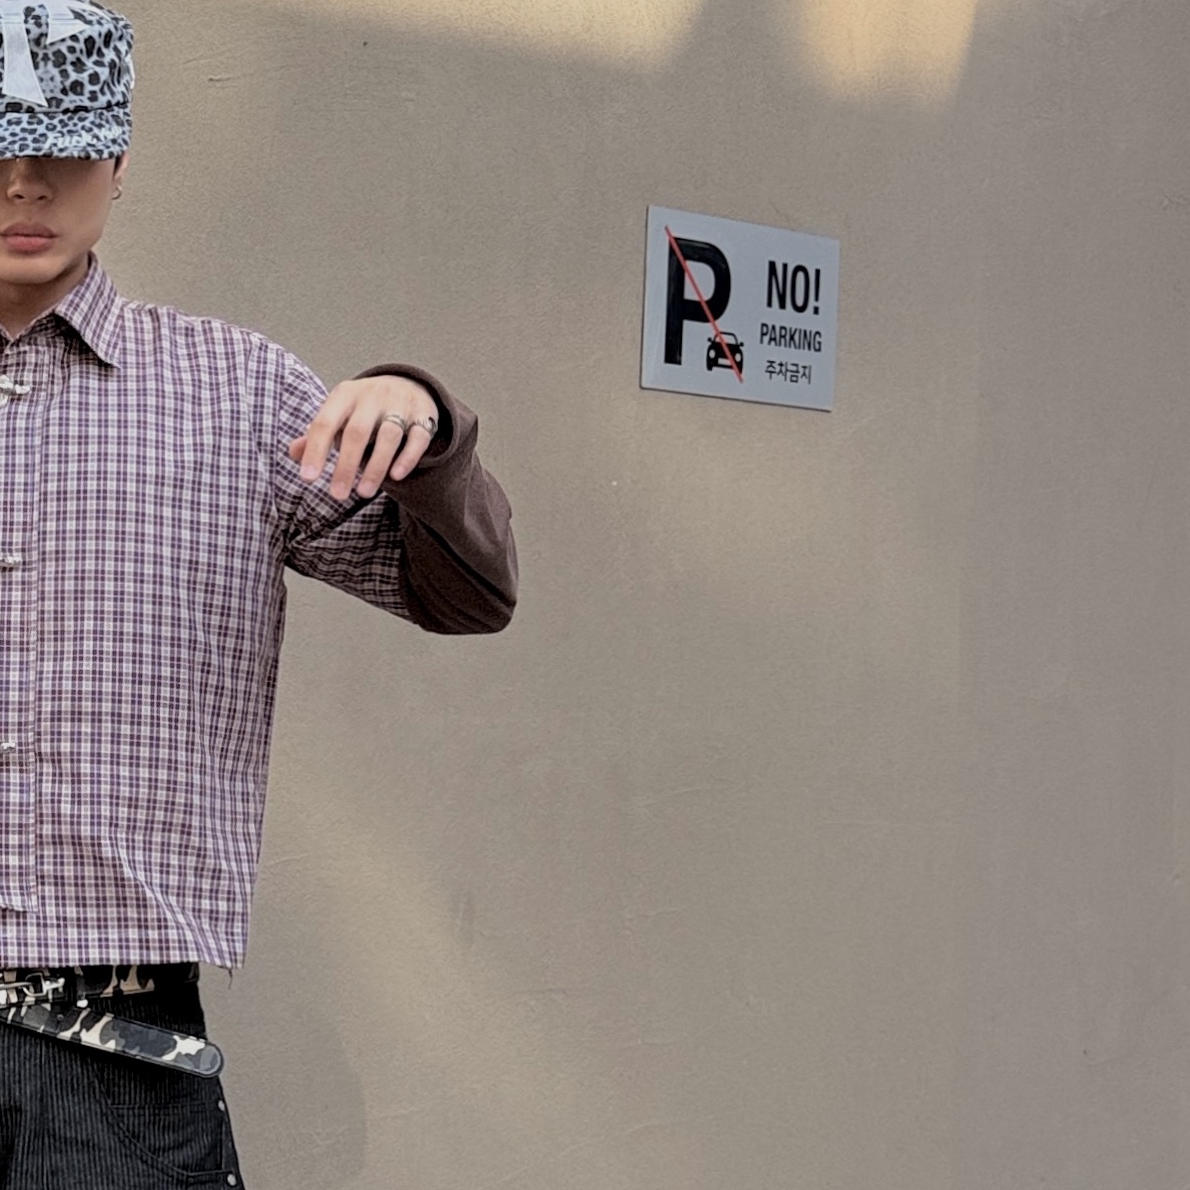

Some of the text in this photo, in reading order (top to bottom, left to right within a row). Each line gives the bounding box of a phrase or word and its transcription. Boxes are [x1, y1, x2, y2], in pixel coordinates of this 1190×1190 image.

[767, 260, 821, 315] NO!
[760, 322, 822, 352] PARKING
[765, 360, 812, 385] 주차금지
